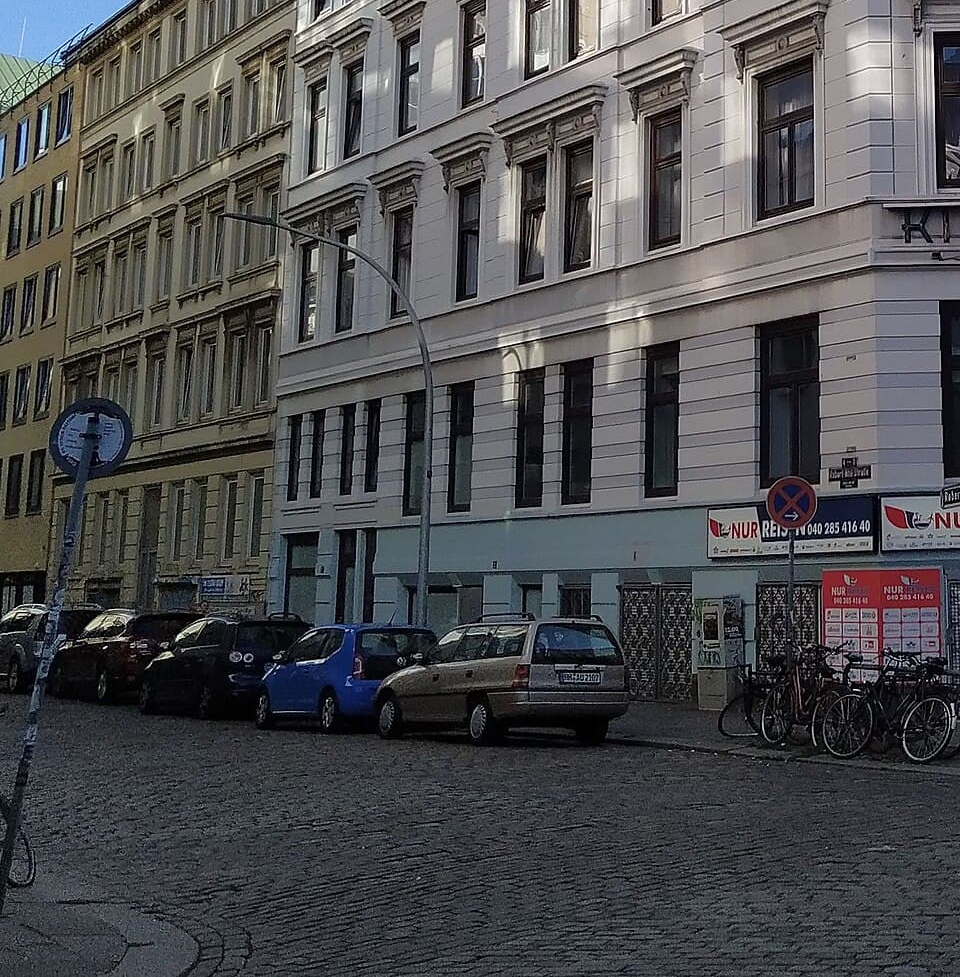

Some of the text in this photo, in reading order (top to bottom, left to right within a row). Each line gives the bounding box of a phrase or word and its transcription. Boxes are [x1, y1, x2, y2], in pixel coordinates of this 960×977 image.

[731, 522, 759, 539] NUR
[807, 523, 822, 535] 040
[824, 522, 839, 535] 285
[841, 520, 857, 533] 416
[859, 519, 871, 533] 40
[831, 586, 846, 596] NUR
[883, 585, 904, 594] NUR
